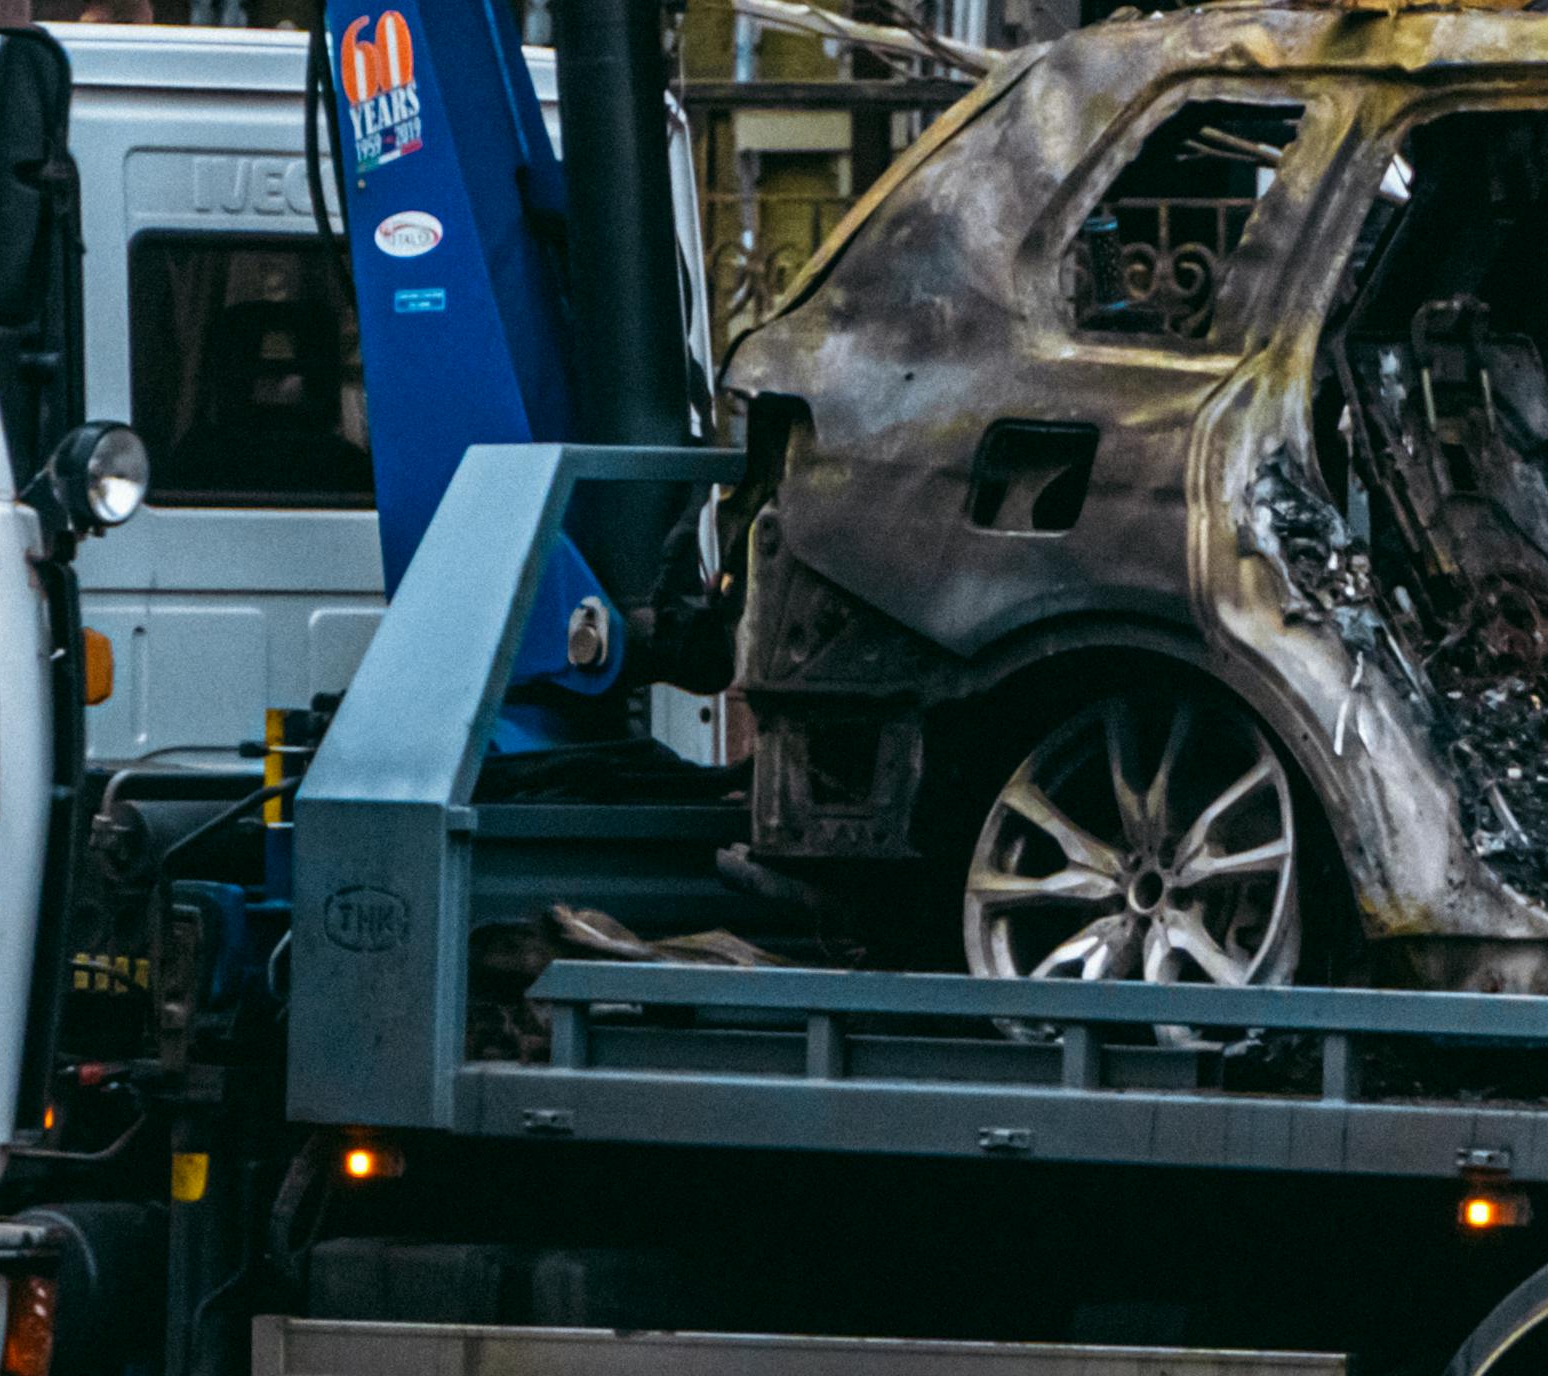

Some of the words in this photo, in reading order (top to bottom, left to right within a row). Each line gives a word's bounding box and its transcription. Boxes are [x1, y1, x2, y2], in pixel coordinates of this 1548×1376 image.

[340, 10, 414, 108] 60
[349, 80, 421, 140] YEARS
[193, 157, 340, 215] IVEC
